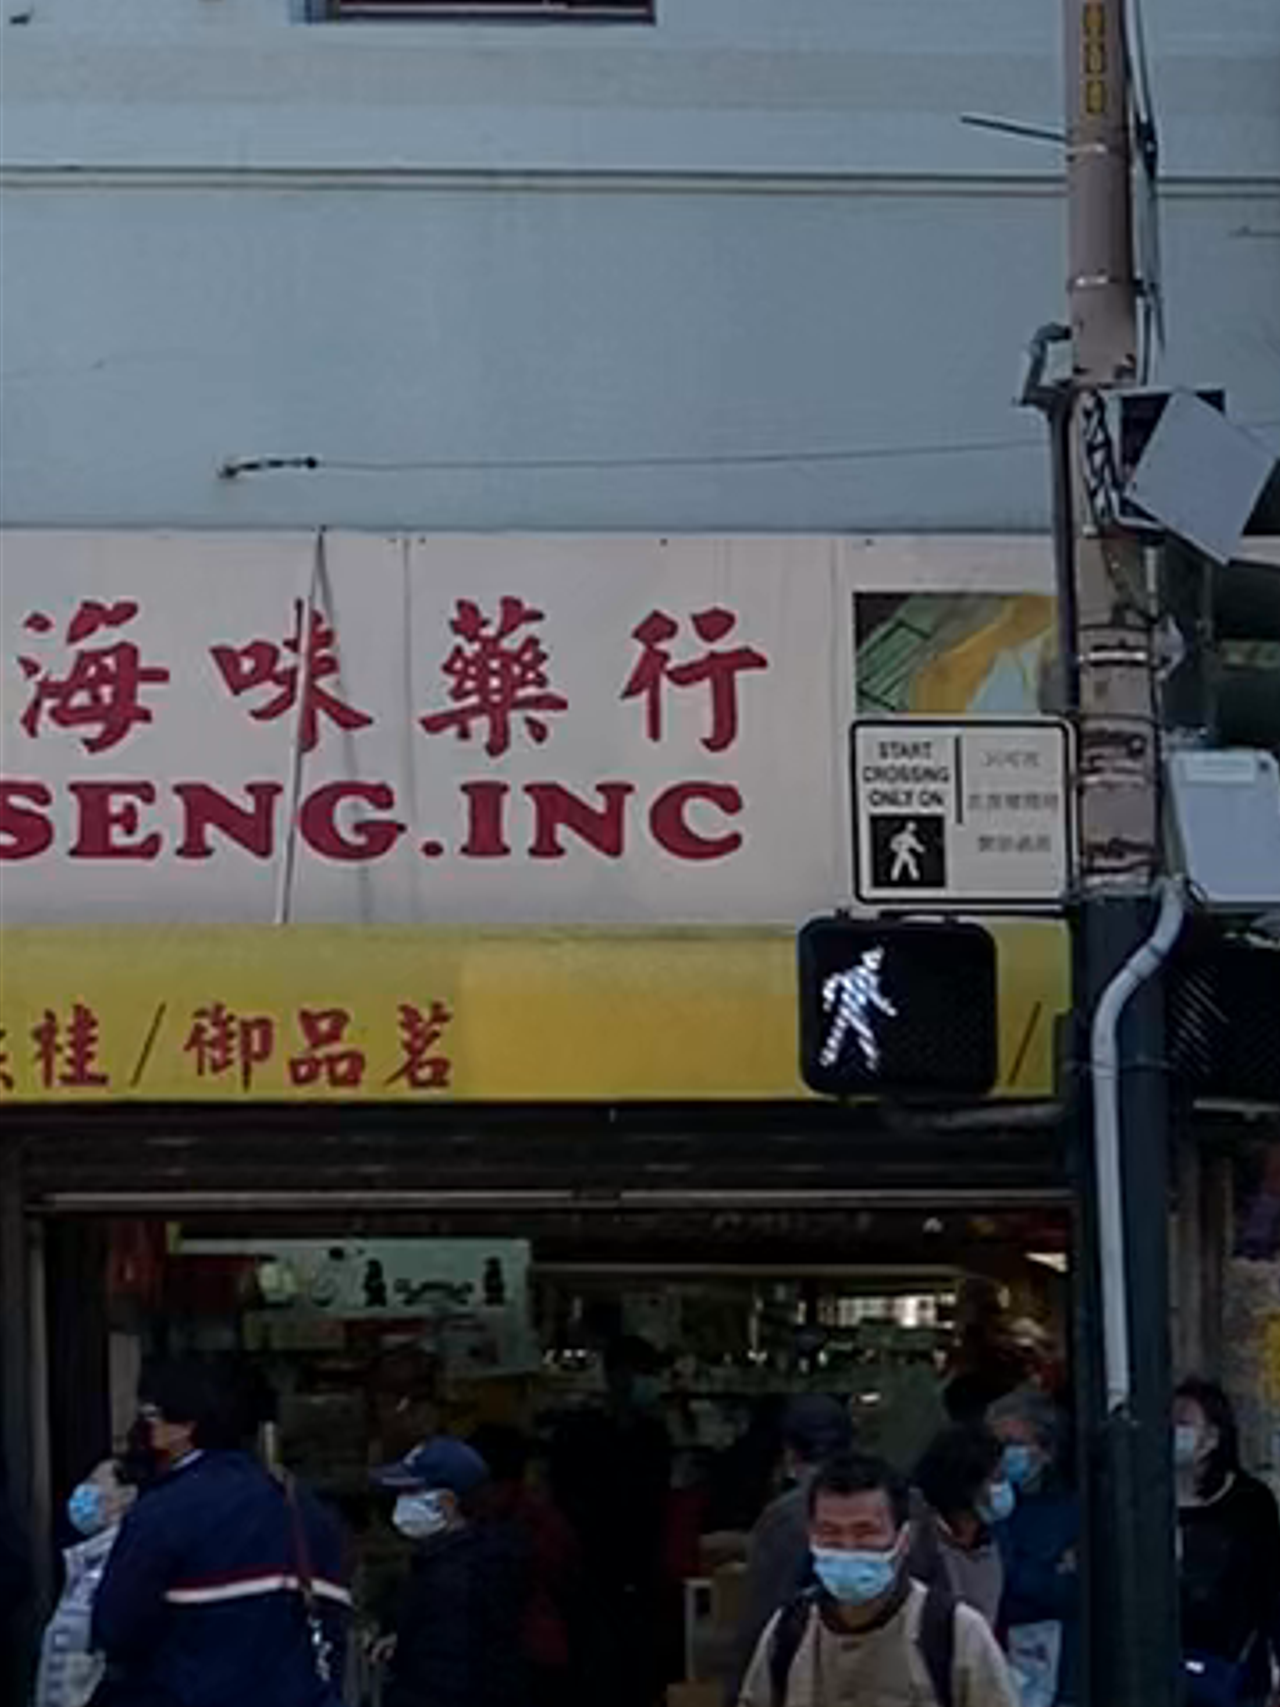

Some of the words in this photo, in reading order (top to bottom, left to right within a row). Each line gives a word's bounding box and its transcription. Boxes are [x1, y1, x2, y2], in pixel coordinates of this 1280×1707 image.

[17, 596, 768, 756] 海味藥行
[879, 741, 932, 760] START
[863, 766, 950, 784] CROSSING
[869, 790, 913, 808] ONLY
[919, 790, 944, 807] ON
[0, 1001, 454, 1090] 桂/御品茗
